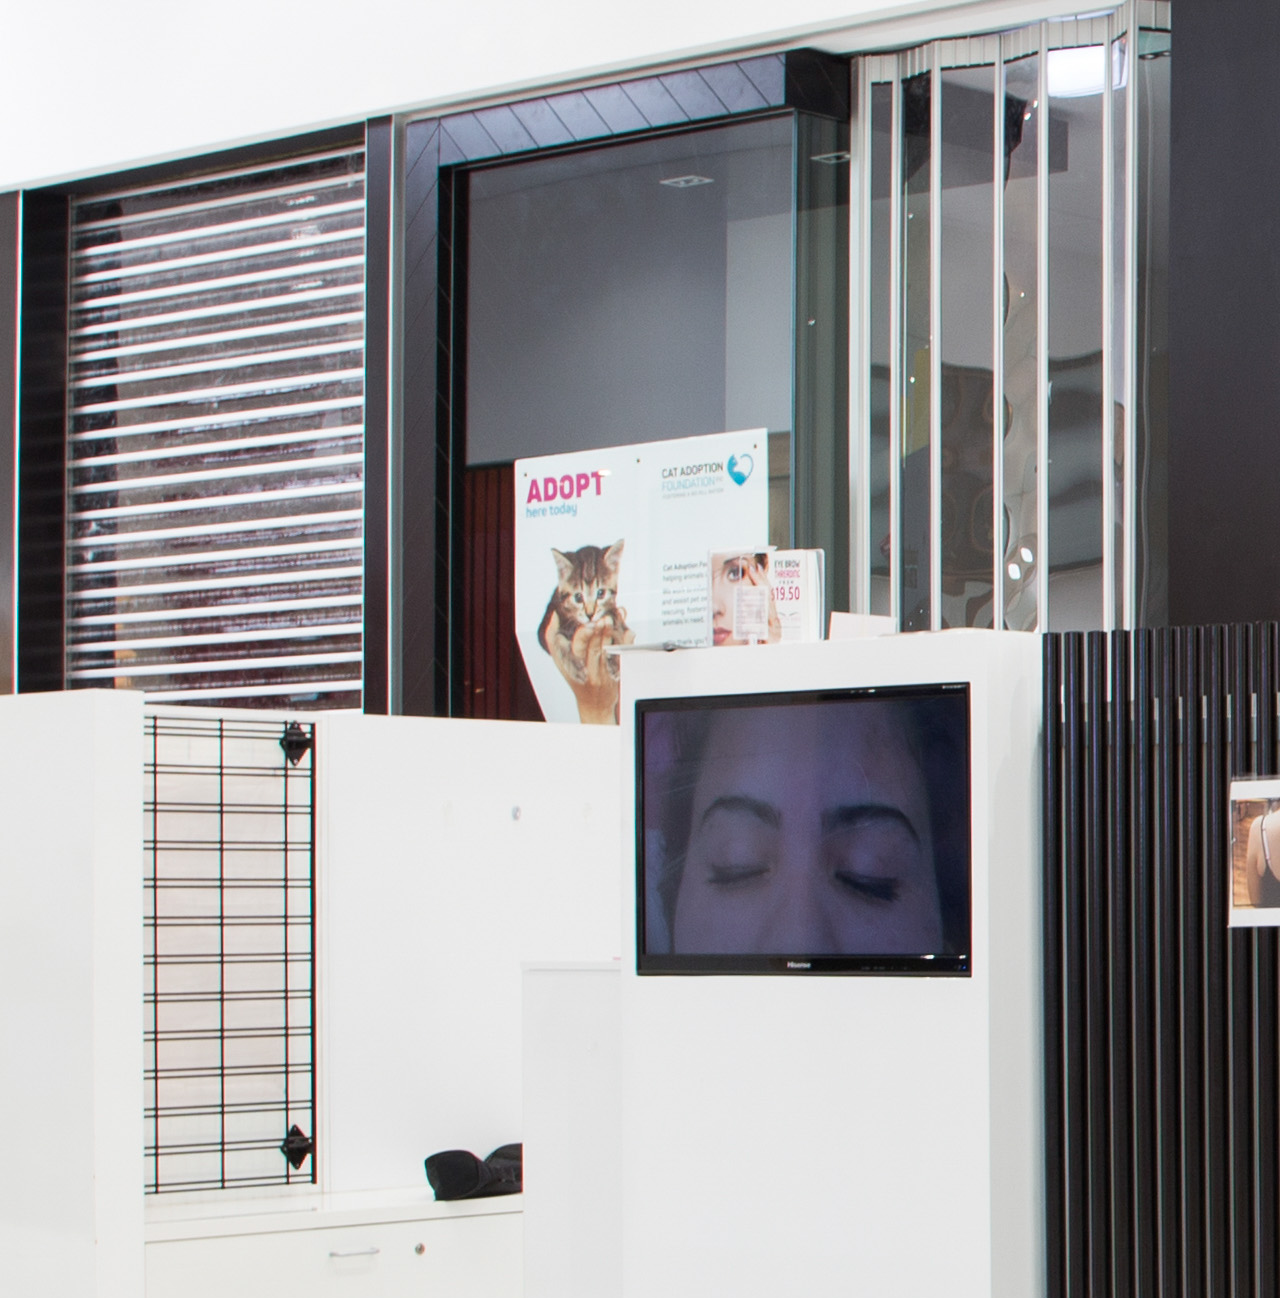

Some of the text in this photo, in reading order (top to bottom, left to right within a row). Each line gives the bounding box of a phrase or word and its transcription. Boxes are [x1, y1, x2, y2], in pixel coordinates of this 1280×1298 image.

[662, 461, 724, 478] CAT ADOPTION
[526, 471, 602, 504] ADOPT
[662, 476, 715, 492] FOUNDATION
[526, 503, 578, 518] here today
[771, 585, 800, 602] $19.50
